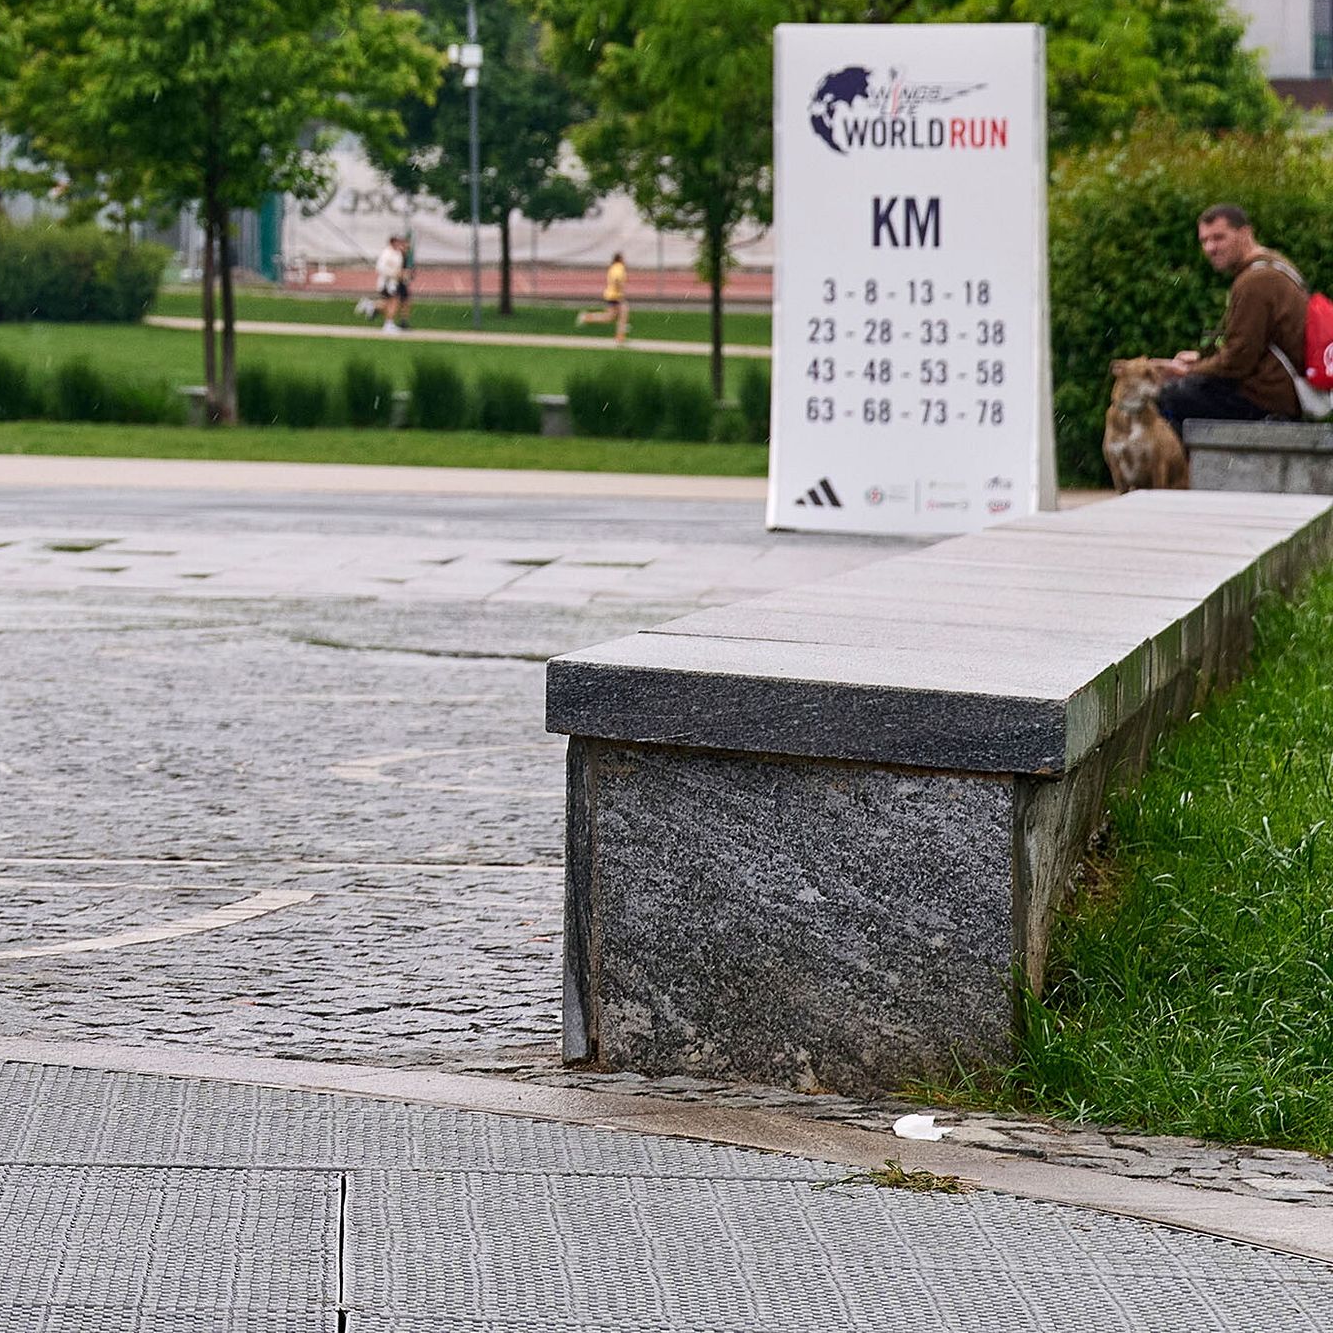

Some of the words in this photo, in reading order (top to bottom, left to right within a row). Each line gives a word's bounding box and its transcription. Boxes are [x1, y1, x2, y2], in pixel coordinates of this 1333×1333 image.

[872, 196, 941, 248] KM
[823, 278, 836, 304] 3
[865, 278, 878, 305] 8
[908, 279, 933, 305] 13
[965, 279, 990, 306] 18
[808, 317, 836, 344] 23
[865, 318, 892, 344] 28
[920, 319, 948, 345] 33
[976, 319, 1005, 345] 38
[807, 357, 835, 383] 43
[863, 358, 892, 384] 48
[920, 359, 948, 385] 53
[976, 359, 1004, 385] 58
[806, 397, 834, 422] 63
[863, 397, 892, 423] 68
[921, 398, 947, 424] 73
[976, 398, 1004, 425] 78
